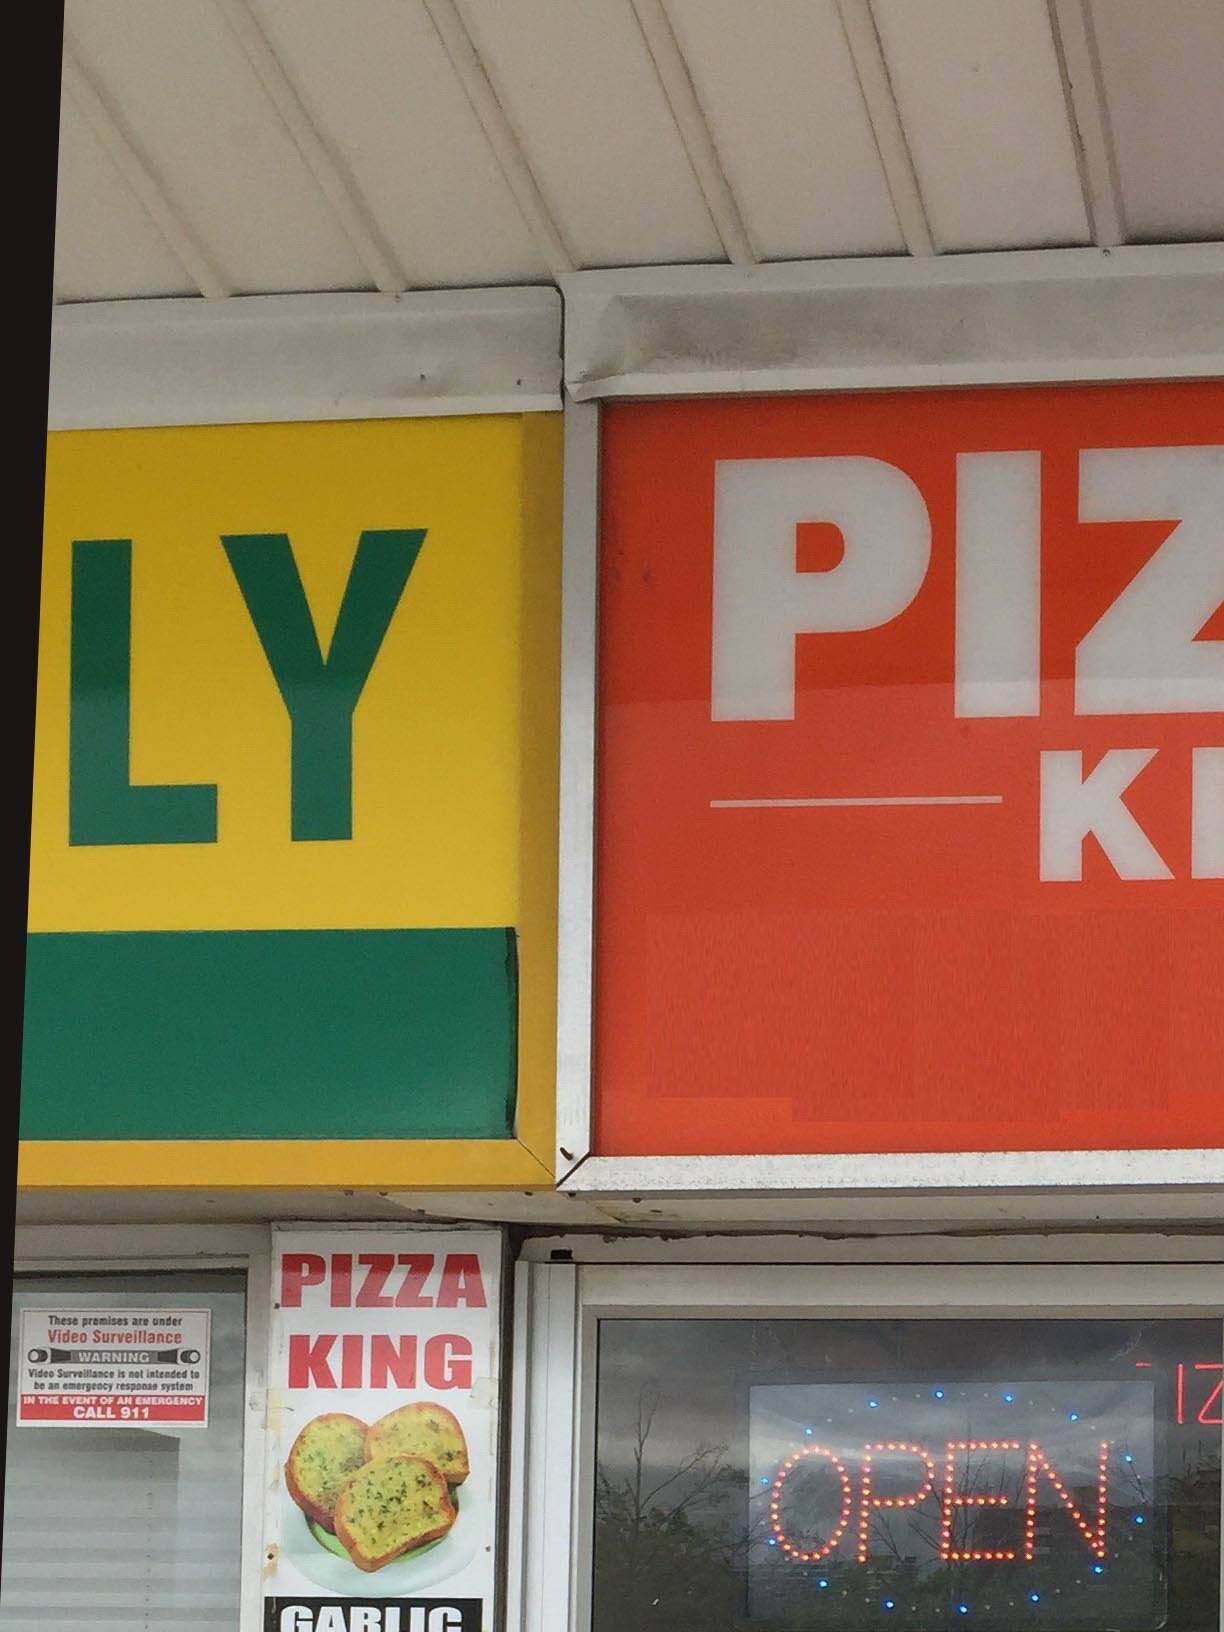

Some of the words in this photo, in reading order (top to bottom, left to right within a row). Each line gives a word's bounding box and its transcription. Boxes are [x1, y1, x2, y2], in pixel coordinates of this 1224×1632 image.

[69, 528, 428, 847] LY
[280, 1253, 487, 1308] PIZZA
[48, 1315, 78, 1326] These
[82, 1316, 128, 1328] premises
[132, 1317, 149, 1326] are
[152, 1315, 183, 1326] under
[48, 1329, 87, 1344] Video
[93, 1329, 182, 1344] Surveillance
[78, 1351, 150, 1363] WARNING
[288, 1334, 473, 1390] KING
[28, 1368, 54, 1379] Video
[57, 1368, 115, 1379] Surveillance
[117, 1369, 125, 1379] is
[128, 1369, 144, 1379] not
[146, 1369, 188, 1379] intended
[190, 1369, 200, 1379] to
[34, 1381, 45, 1391] be
[47, 1382, 59, 1391] an
[62, 1382, 113, 1393] emergency
[116, 1382, 158, 1393] response
[161, 1382, 193, 1393] system
[24, 1396, 35, 1405] IN
[38, 1396, 59, 1405] THE
[62, 1396, 98, 1405] EVENT
[101, 1396, 114, 1405] OF
[117, 1396, 133, 1405] AN
[135, 1396, 202, 1406] EMERGENCY
[73, 1406, 115, 1420] CALL
[121, 1406, 150, 1419] 911
[771, 1440, 1108, 1563] OPEN
